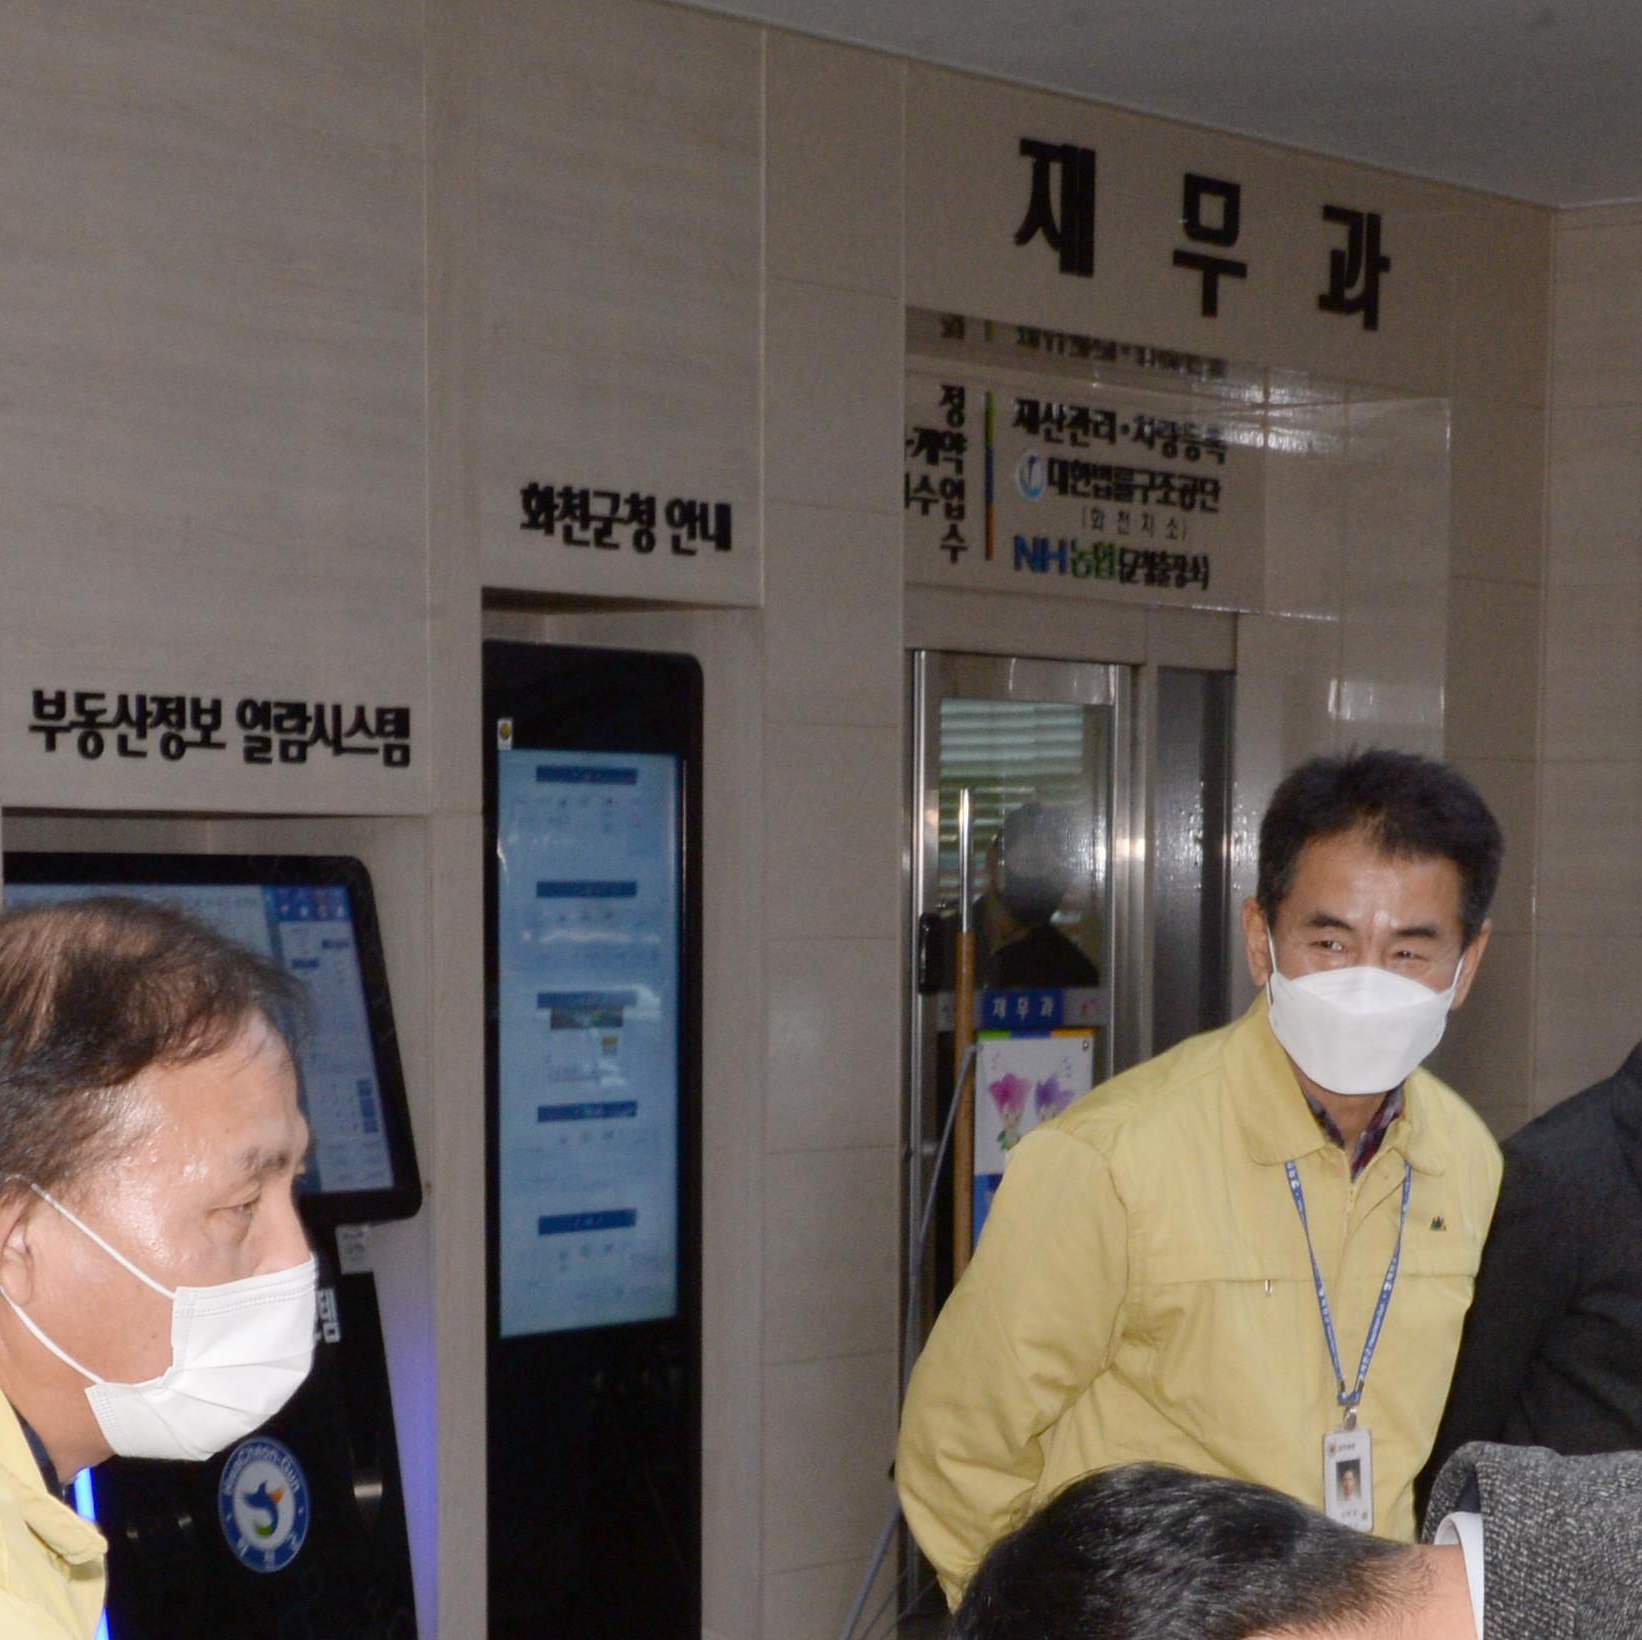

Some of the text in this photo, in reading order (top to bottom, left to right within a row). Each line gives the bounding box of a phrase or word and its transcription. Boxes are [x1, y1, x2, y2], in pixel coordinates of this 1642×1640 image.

[1013, 137, 1391, 331] 재무과
[521, 482, 732, 556] 화천군청 안내
[1047, 456, 1221, 514] 대한법률구조공단
[29, 690, 410, 767] 부동산정보 열람시스템
